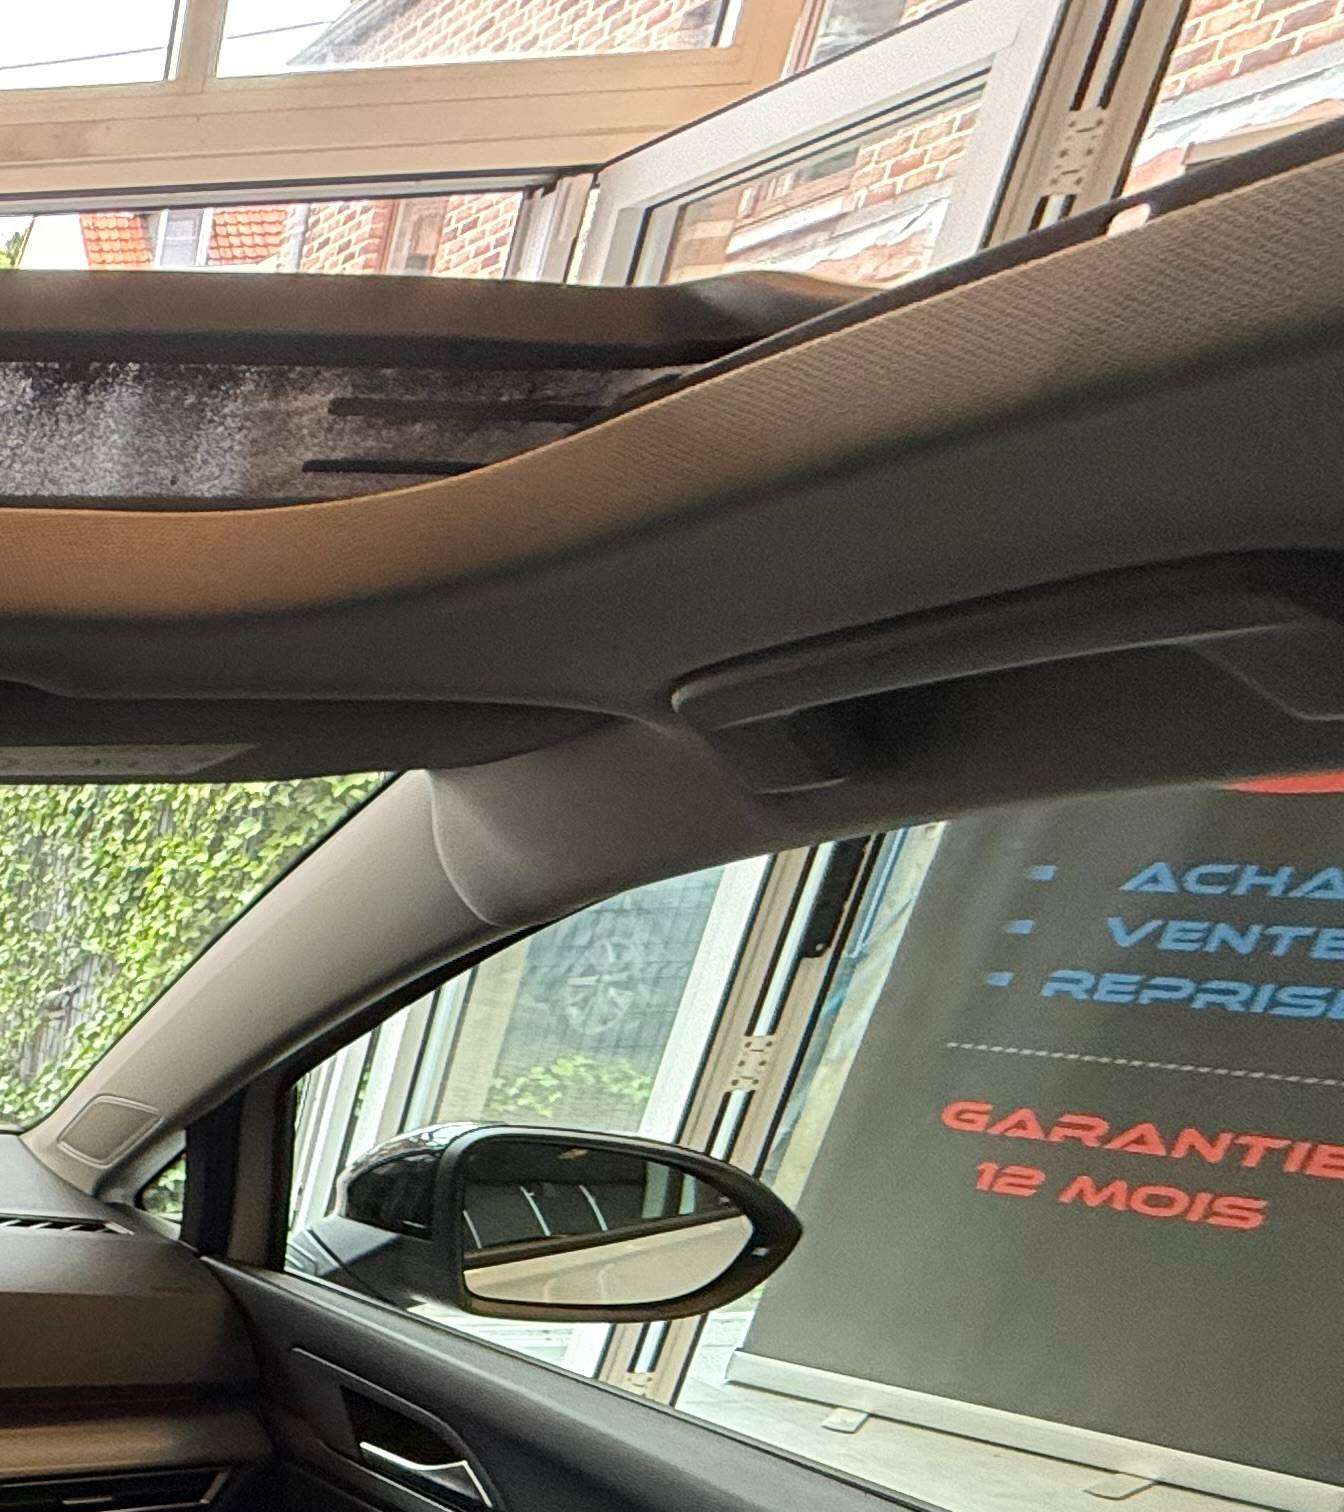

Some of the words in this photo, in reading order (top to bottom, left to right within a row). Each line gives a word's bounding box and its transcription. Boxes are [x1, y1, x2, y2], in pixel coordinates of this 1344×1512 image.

[1121, 861, 1344, 899] ACHA
[1107, 916, 1344, 959] VENTE
[941, 1100, 1344, 1180] GARANTIE
[975, 1161, 1045, 1198] 12
[1059, 1174, 1268, 1231] MOIS
